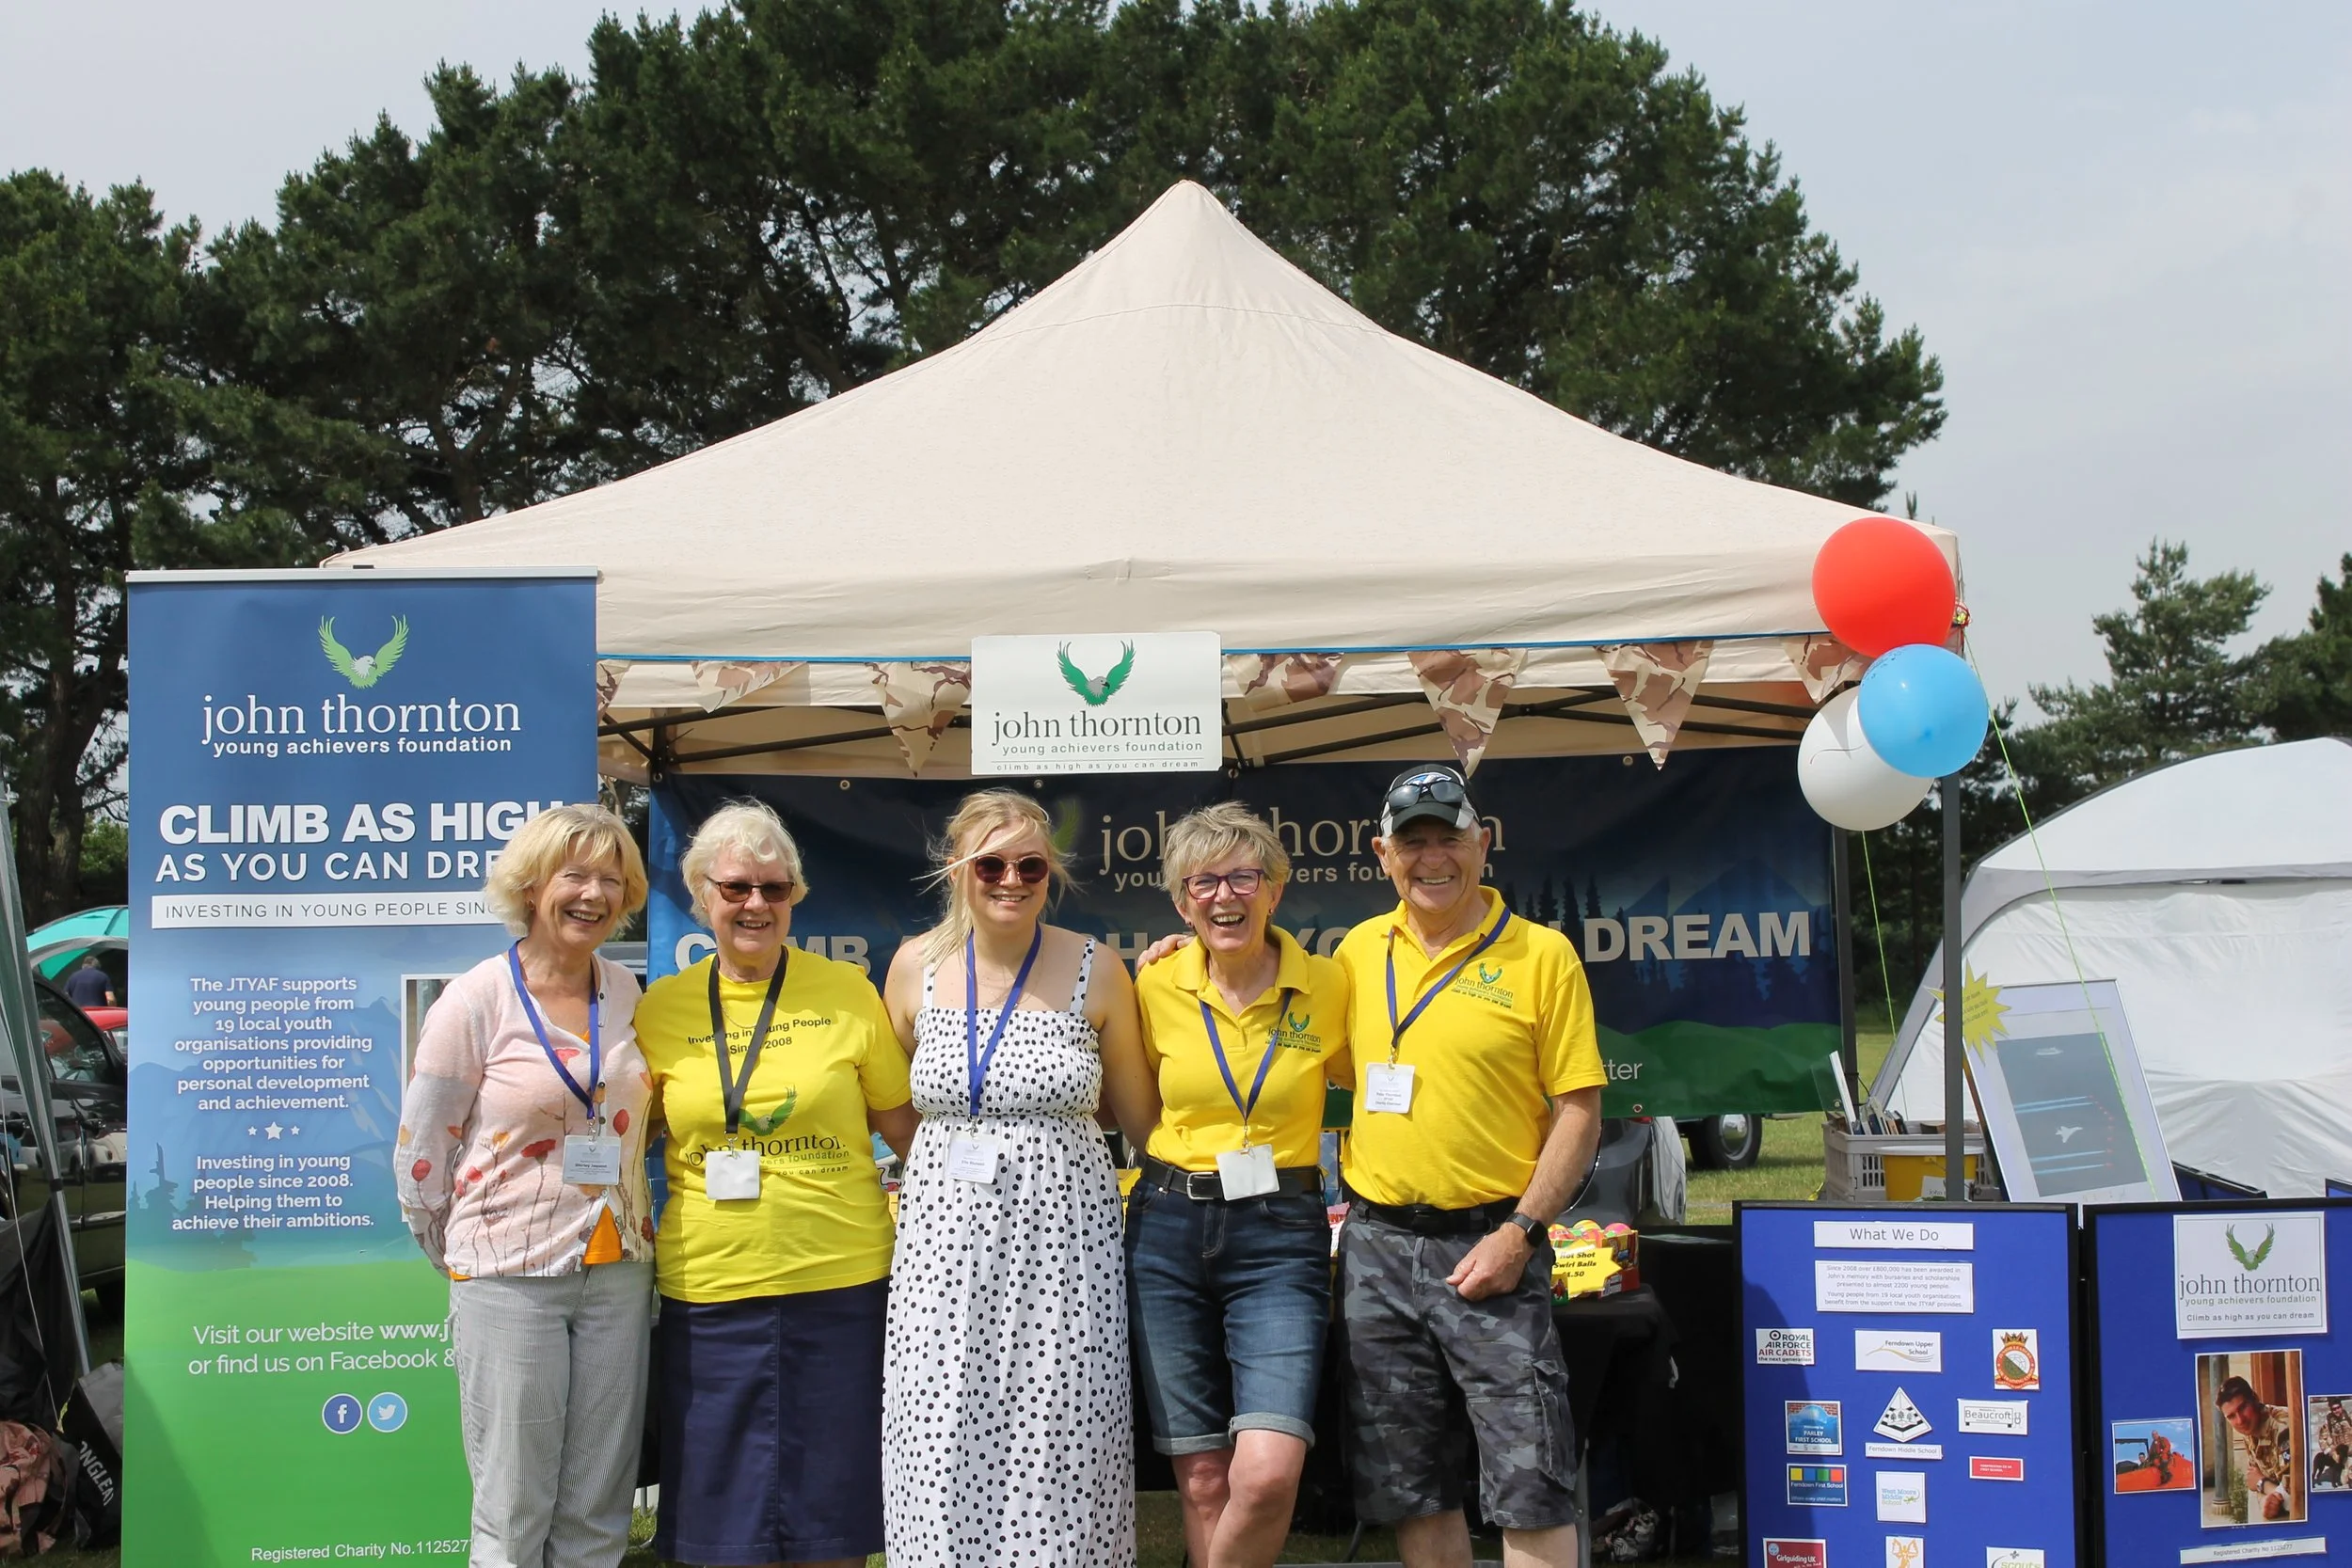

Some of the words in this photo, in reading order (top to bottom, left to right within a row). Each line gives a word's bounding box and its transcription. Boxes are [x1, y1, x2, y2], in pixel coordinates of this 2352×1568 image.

[202, 695, 305, 745] john
[322, 694, 520, 733] thornton
[992, 712, 1060, 746] john
[1070, 711, 1200, 737] thornton
[214, 743, 278, 757] young
[287, 738, 389, 753] achievers
[398, 736, 510, 752] foundation
[1003, 745, 1044, 756] young
[1051, 743, 1120, 752] achievers
[1126, 741, 1202, 752] foundation
[1056, 762, 1081, 770] high
[160, 805, 329, 844] CLIMB
[342, 803, 415, 842] AS
[156, 854, 205, 881] AS
[222, 853, 306, 880] YOU
[326, 852, 407, 879] CAN
[428, 851, 503, 879] DRE
[1115, 873, 1164, 892] you
[166, 905, 270, 919] INVESTING
[276, 904, 292, 918] IN
[302, 903, 368, 917] YOUNG
[375, 902, 448, 916] PEOPLE
[1584, 911, 1811, 962] DREAM
[191, 978, 222, 991] The
[227, 978, 278, 990] JTYAF
[283, 977, 357, 994] supports
[1455, 977, 1475, 987] john
[1477, 982, 1513, 998] thornton
[194, 1001, 246, 1015] young
[251, 997, 310, 1014] people
[315, 997, 353, 1009] from
[216, 1020, 234, 1033] 19
[240, 1017, 281, 1030] local
[284, 1016, 331, 1034] youth
[689, 1031, 739, 1044] Invesng
[742, 1029, 752, 1037] in
[766, 1022, 789, 1035] ung
[793, 1018, 831, 1030] People
[1268, 1026, 1287, 1037] john
[1290, 1031, 1320, 1042] thornton
[175, 1037, 289, 1054] organisations
[294, 1036, 372, 1053] providing
[730, 1044, 761, 1054] Sin
[765, 1037, 792, 1049] 2008
[203, 1056, 317, 1073] opportunities
[322, 1055, 345, 1069] for
[179, 1076, 252, 1094] personal
[257, 1075, 369, 1092] development
[199, 1096, 230, 1110] and
[235, 1095, 348, 1109] achievement.
[198, 1155, 274, 1171] Investing
[279, 1155, 294, 1167] in
[298, 1157, 350, 1171] young
[788, 1150, 849, 1163] foundation
[821, 1165, 848, 1174] dream
[195, 1175, 254, 1193] people
[259, 1175, 303, 1188] since
[308, 1174, 353, 1187] 2008.
[206, 1195, 271, 1212] Helping
[277, 1194, 320, 1207] them
[326, 1194, 342, 1206] to
[173, 1215, 238, 1229] achieve
[244, 1214, 282, 1227] their
[287, 1212, 373, 1227] ambitions.
[1850, 1227, 1887, 1242] What
[1892, 1228, 1914, 1242] We
[1920, 1229, 1939, 1242] Do
[2181, 1275, 2226, 1299] john
[2234, 1275, 2320, 1293] thornton
[2185, 1297, 2214, 1307] young
[2217, 1296, 2264, 1305] achievers
[2266, 1294, 2316, 1304] foundation
[2224, 1313, 2239, 1323] high
[194, 1325, 240, 1344] Visit
[246, 1329, 282, 1342] our
[287, 1322, 373, 1341] website
[379, 1319, 449, 1342] www.j
[189, 1360, 212, 1374] or
[216, 1354, 258, 1373] find
[265, 1358, 290, 1371] us
[296, 1357, 323, 1370] on
[331, 1349, 437, 1370] Facebook
[1965, 1410, 2011, 1419] Beaucroft
[251, 1545, 329, 1563] Registered
[335, 1544, 387, 1559] Charity
[391, 1539, 473, 1555] No.112527
[1777, 1555, 1806, 1563] Girlguiding
